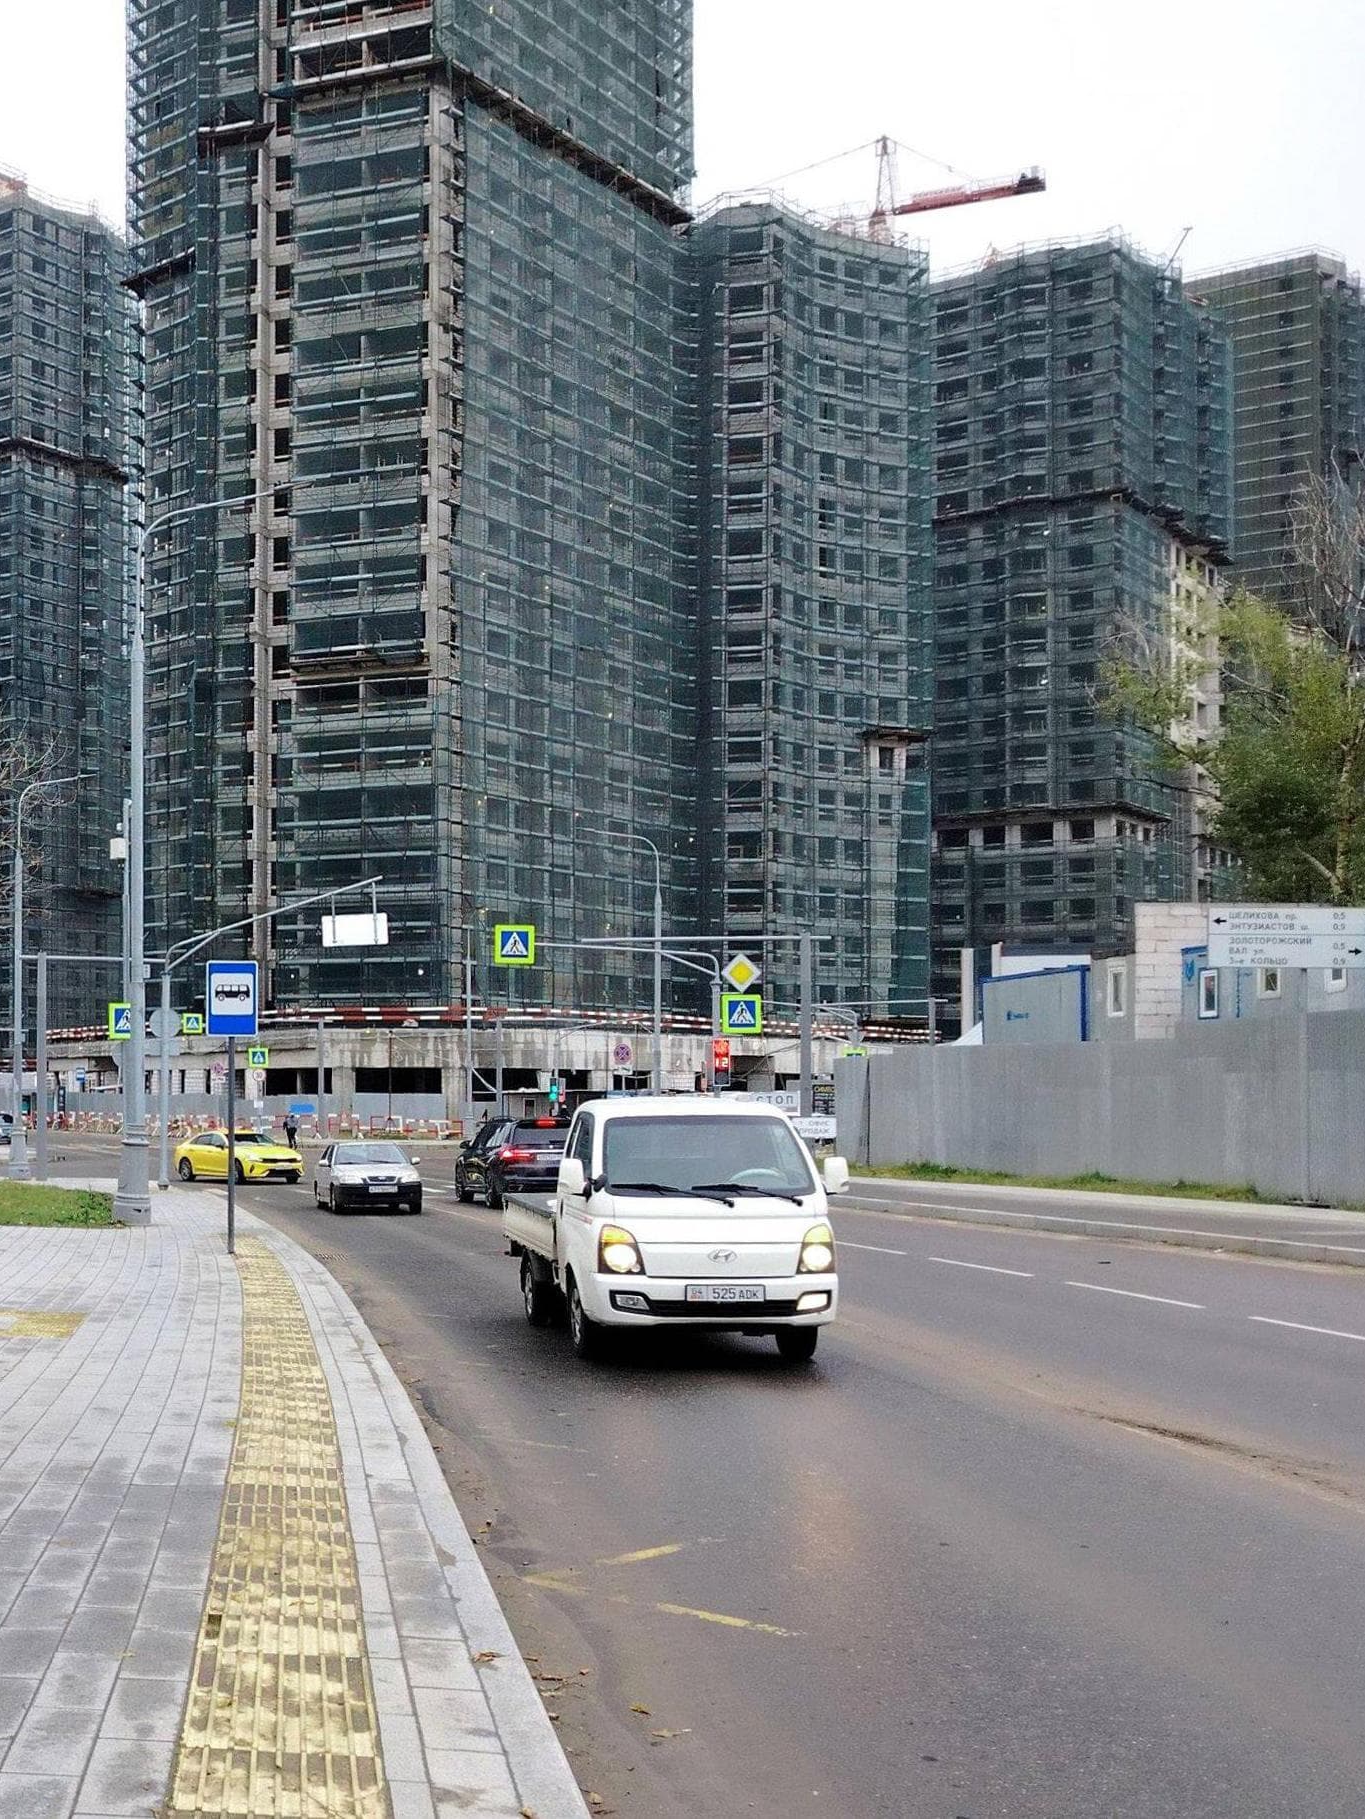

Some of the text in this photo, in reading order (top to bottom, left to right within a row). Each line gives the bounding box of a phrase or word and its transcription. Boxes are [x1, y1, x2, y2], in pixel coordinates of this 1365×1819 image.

[1229, 923, 1295, 931] ЭНТУЗИАСТОВ
[1228, 947, 1247, 955] ВАЛ
[1250, 957, 1288, 966] КОЛЬЦО
[712, 1287, 736, 1300] 525
